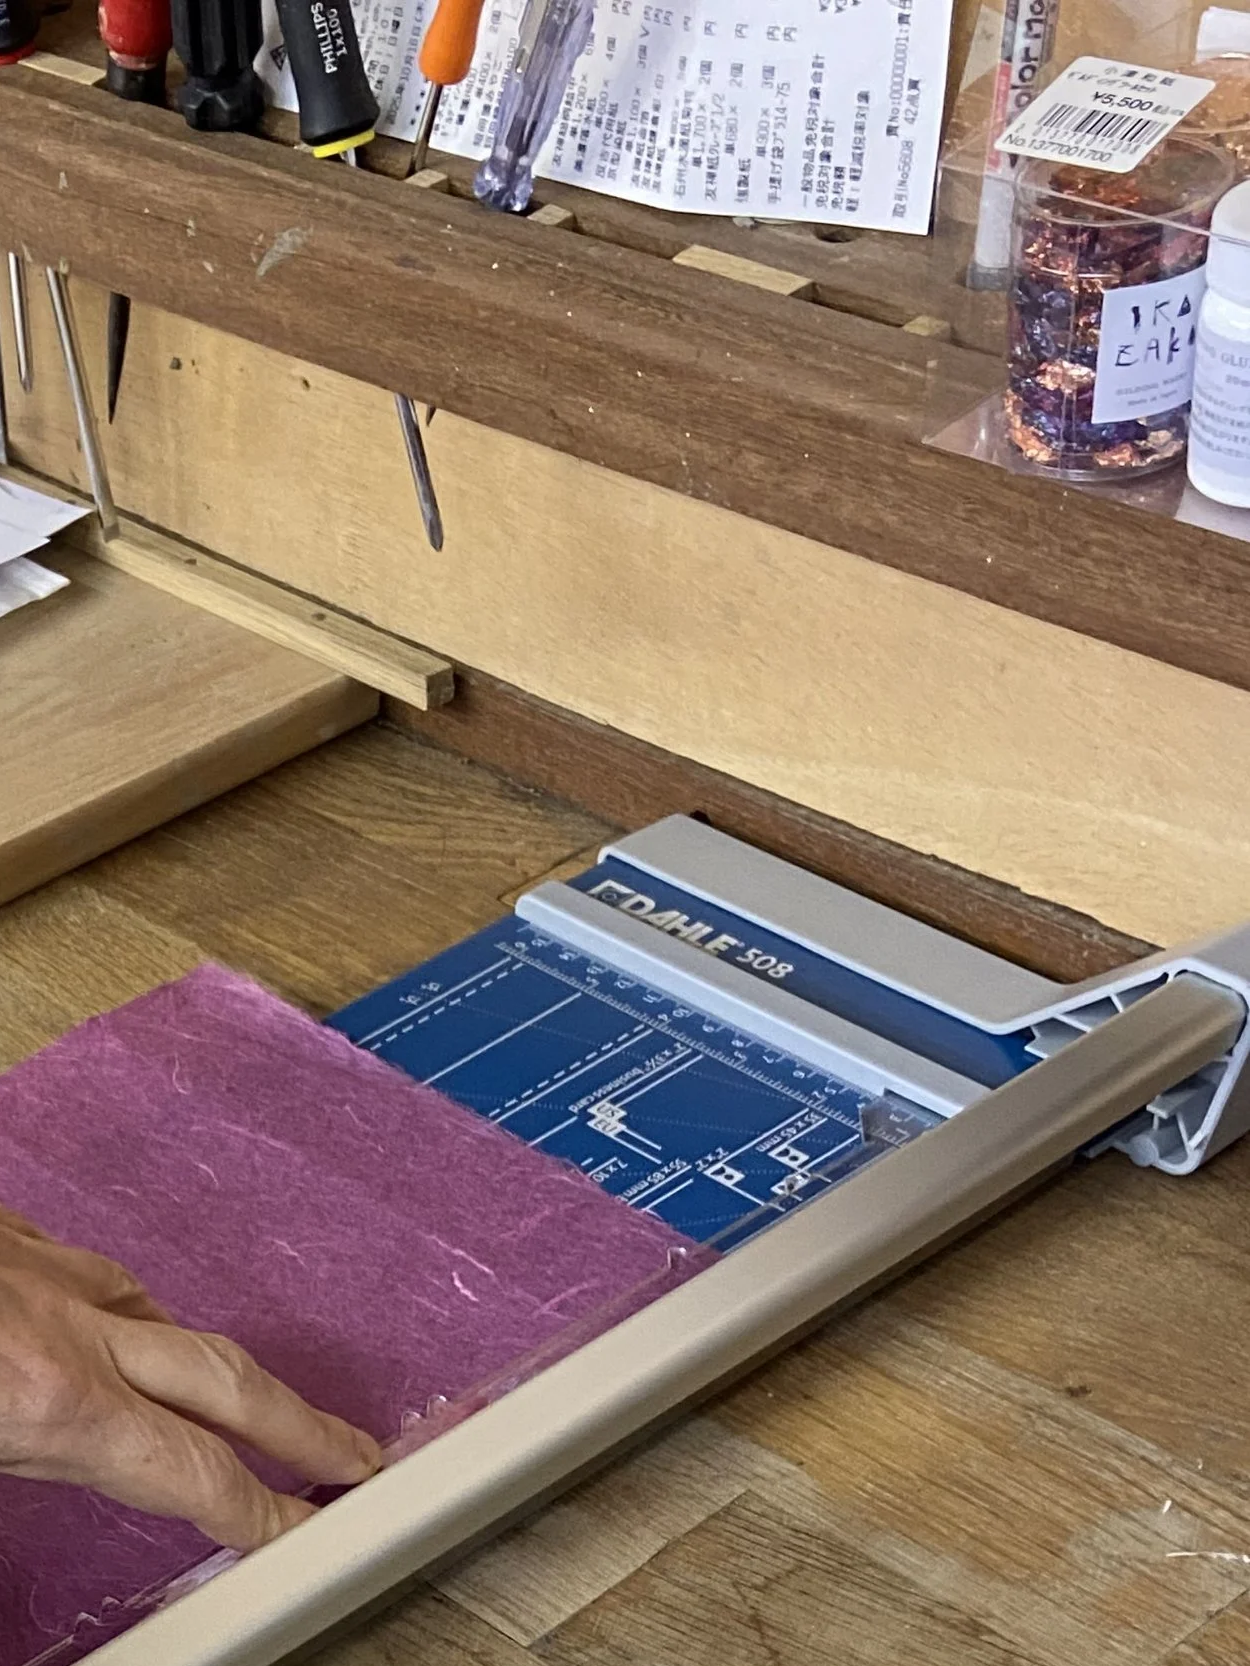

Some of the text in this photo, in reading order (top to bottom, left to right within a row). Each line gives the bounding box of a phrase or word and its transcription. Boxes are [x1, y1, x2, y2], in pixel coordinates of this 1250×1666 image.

[311, 2, 338, 73] PHILLIPS
[1093, 91, 1154, 112] ¥5,500
[800, 52, 826, 208] 一般物品免税対象合計
[815, 117, 836, 209] 免税対象合計
[831, 166, 847, 211] 免税額
[1221, 352, 1250, 369] GLU
[618, 892, 795, 980] DAHLE 508
[591, 1067, 644, 1099] business
[568, 1093, 595, 1113] card
[755, 1137, 782, 1153] mm
